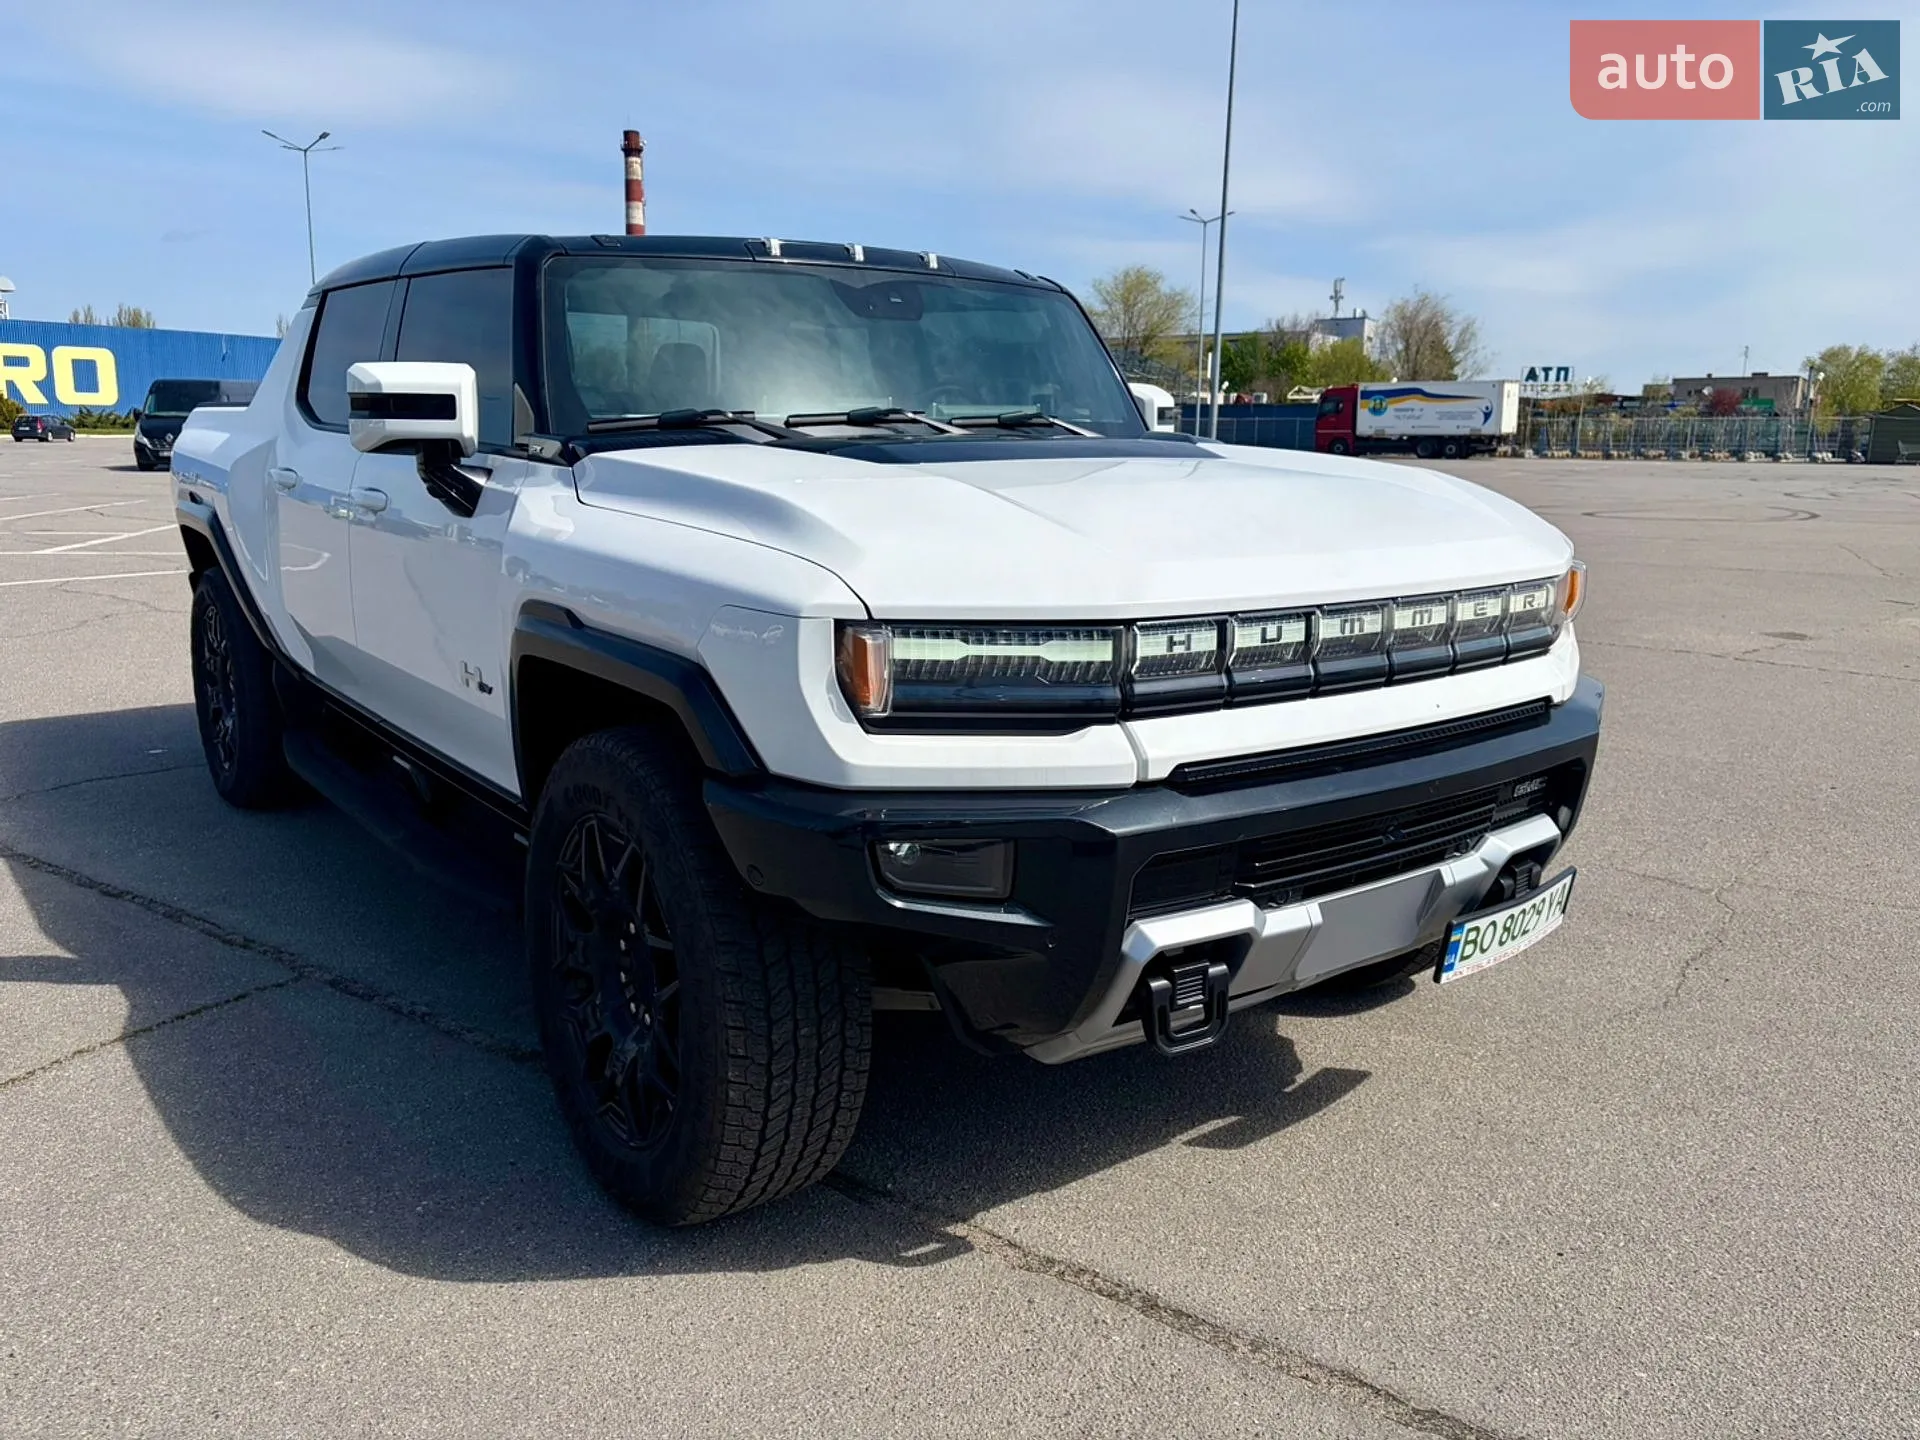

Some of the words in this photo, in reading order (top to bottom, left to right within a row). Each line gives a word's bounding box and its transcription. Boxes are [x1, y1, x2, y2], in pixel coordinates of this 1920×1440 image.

[0, 342, 118, 405] RO
[1524, 366, 1570, 382] АТП
[1165, 593, 1536, 653] HUMMER
[1459, 920, 1497, 961] BO
[1498, 897, 1546, 947] 8029
